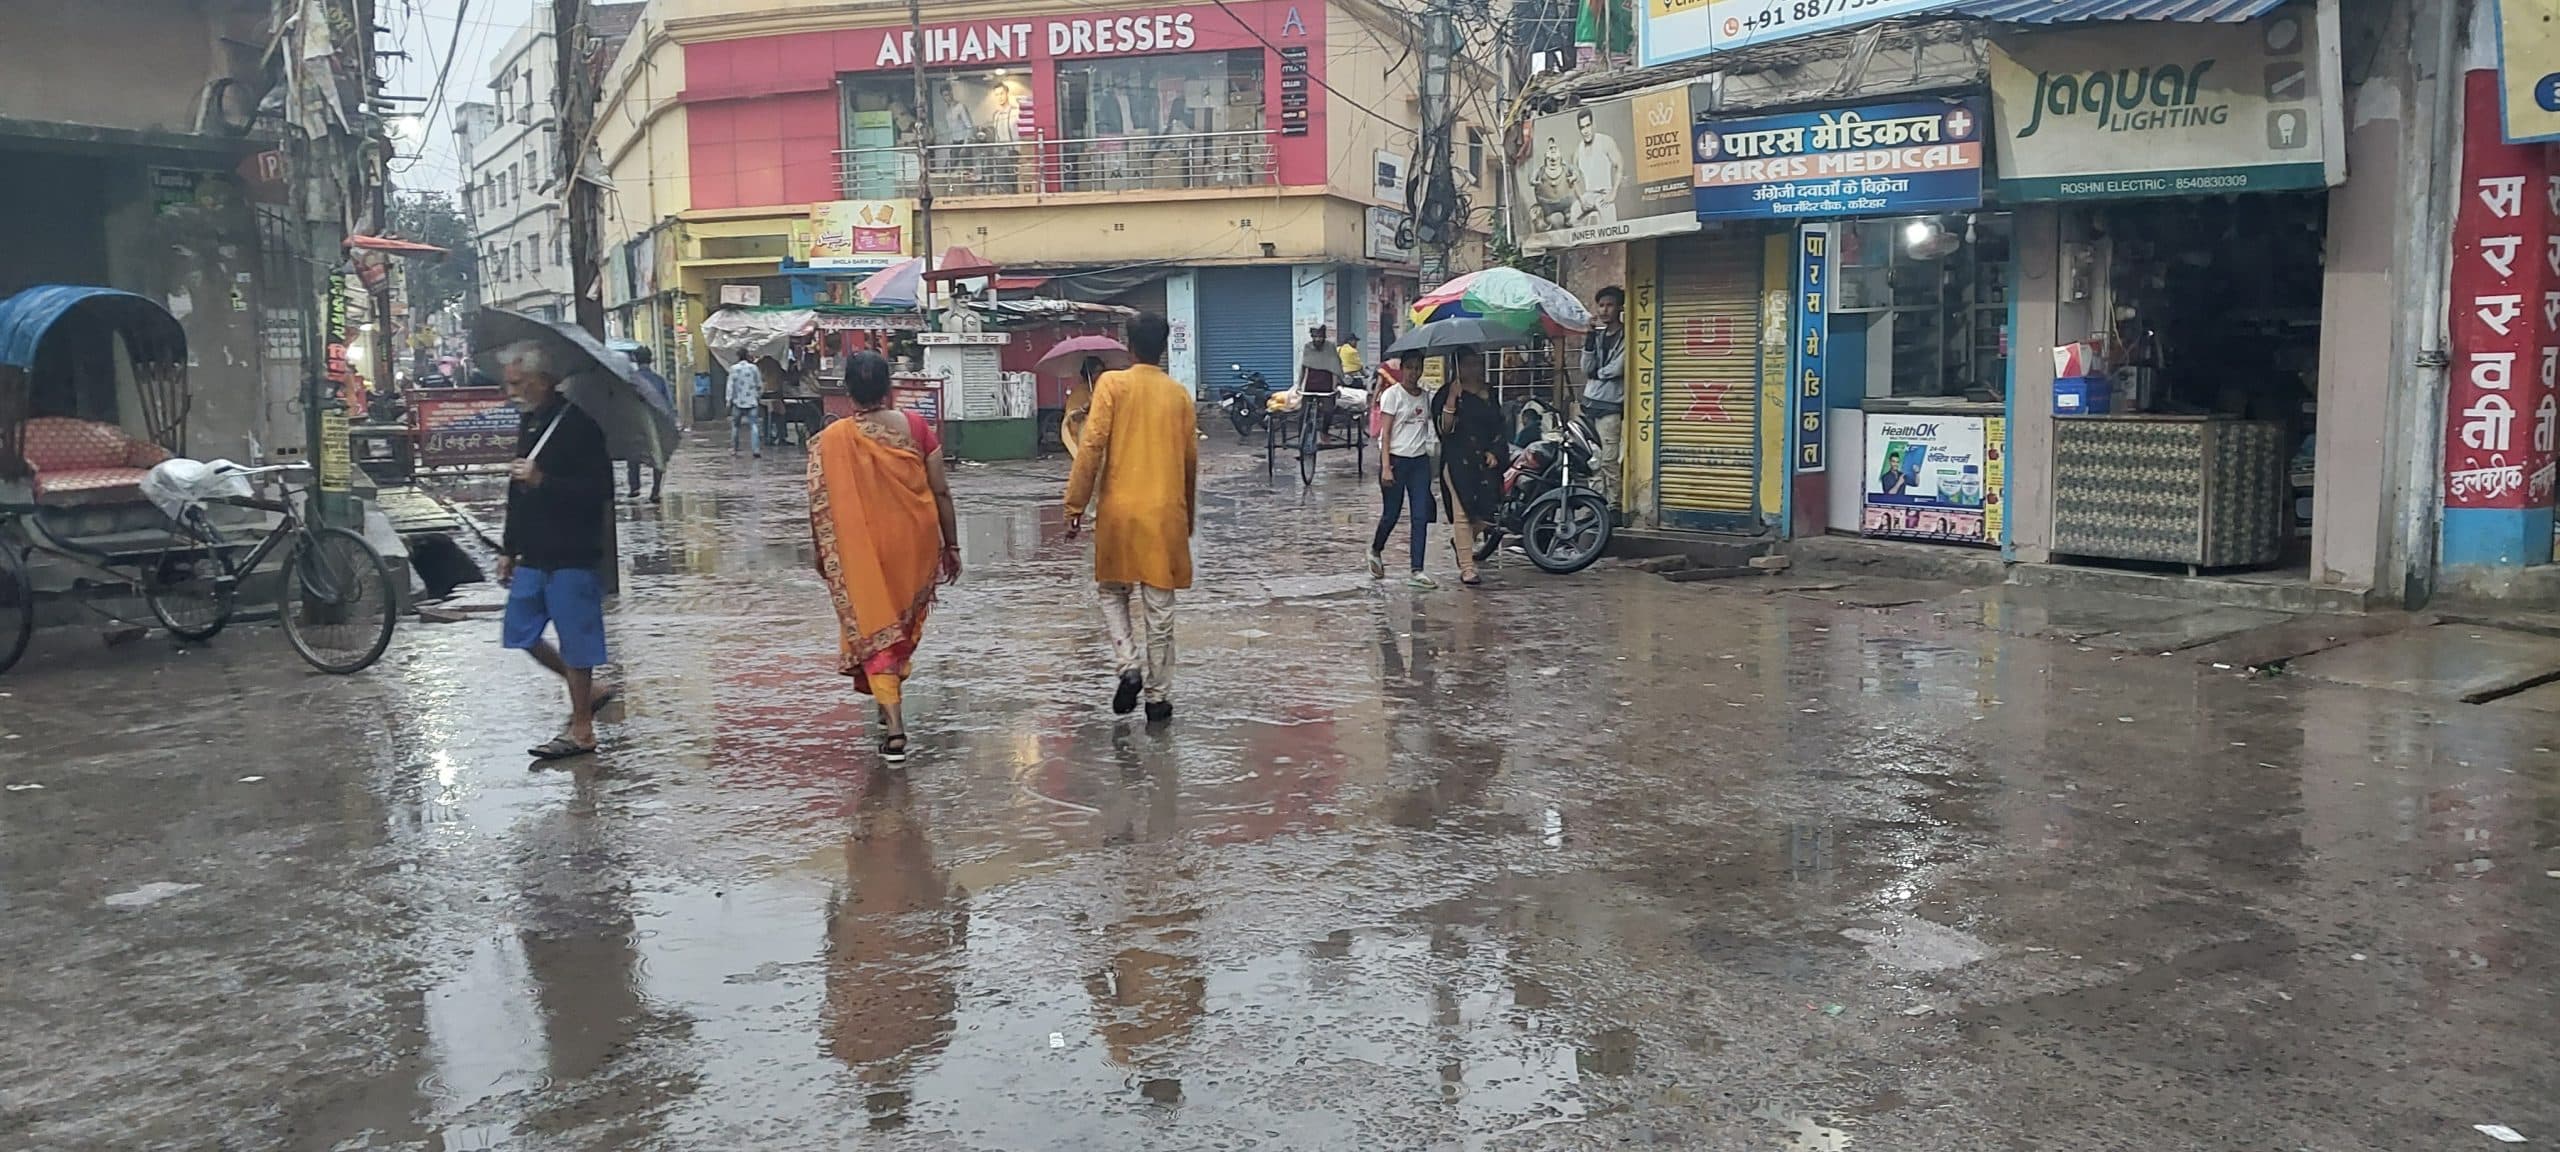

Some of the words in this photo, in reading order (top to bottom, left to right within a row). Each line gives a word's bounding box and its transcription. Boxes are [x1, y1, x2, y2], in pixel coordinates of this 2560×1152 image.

[1281, 6, 1307, 37] A
[1743, 9, 1785, 32] +91
[876, 24, 1032, 67] ARIHANT
[1048, 13, 1195, 56] DRESSES
[2110, 104, 2229, 132] LIGHTING
[1645, 131, 1680, 147] DIXCY
[1722, 126, 1805, 158] पारस
[1810, 110, 1942, 151] मेडिकल
[1646, 143, 1681, 160] SCOTT
[1701, 156, 1809, 183] PARAS
[1818, 144, 1970, 174] MEDICAL
[1752, 183, 1795, 201] अंग्रेजी
[1842, 180, 1859, 195] के
[1861, 177, 1909, 195] विक्रेता
[2060, 181, 2104, 194] ROSHNI
[2107, 178, 2166, 193] ELECTRIC
[2176, 175, 2247, 190] 8540830309
[1570, 229, 1597, 241] INNER
[1598, 224, 1630, 238] WORLD
[1806, 236, 1825, 313] पारस
[2461, 175, 2526, 451] सरस्वती
[1803, 327, 1821, 463] मेडिकल
[1881, 423, 1939, 437] HealthOK
